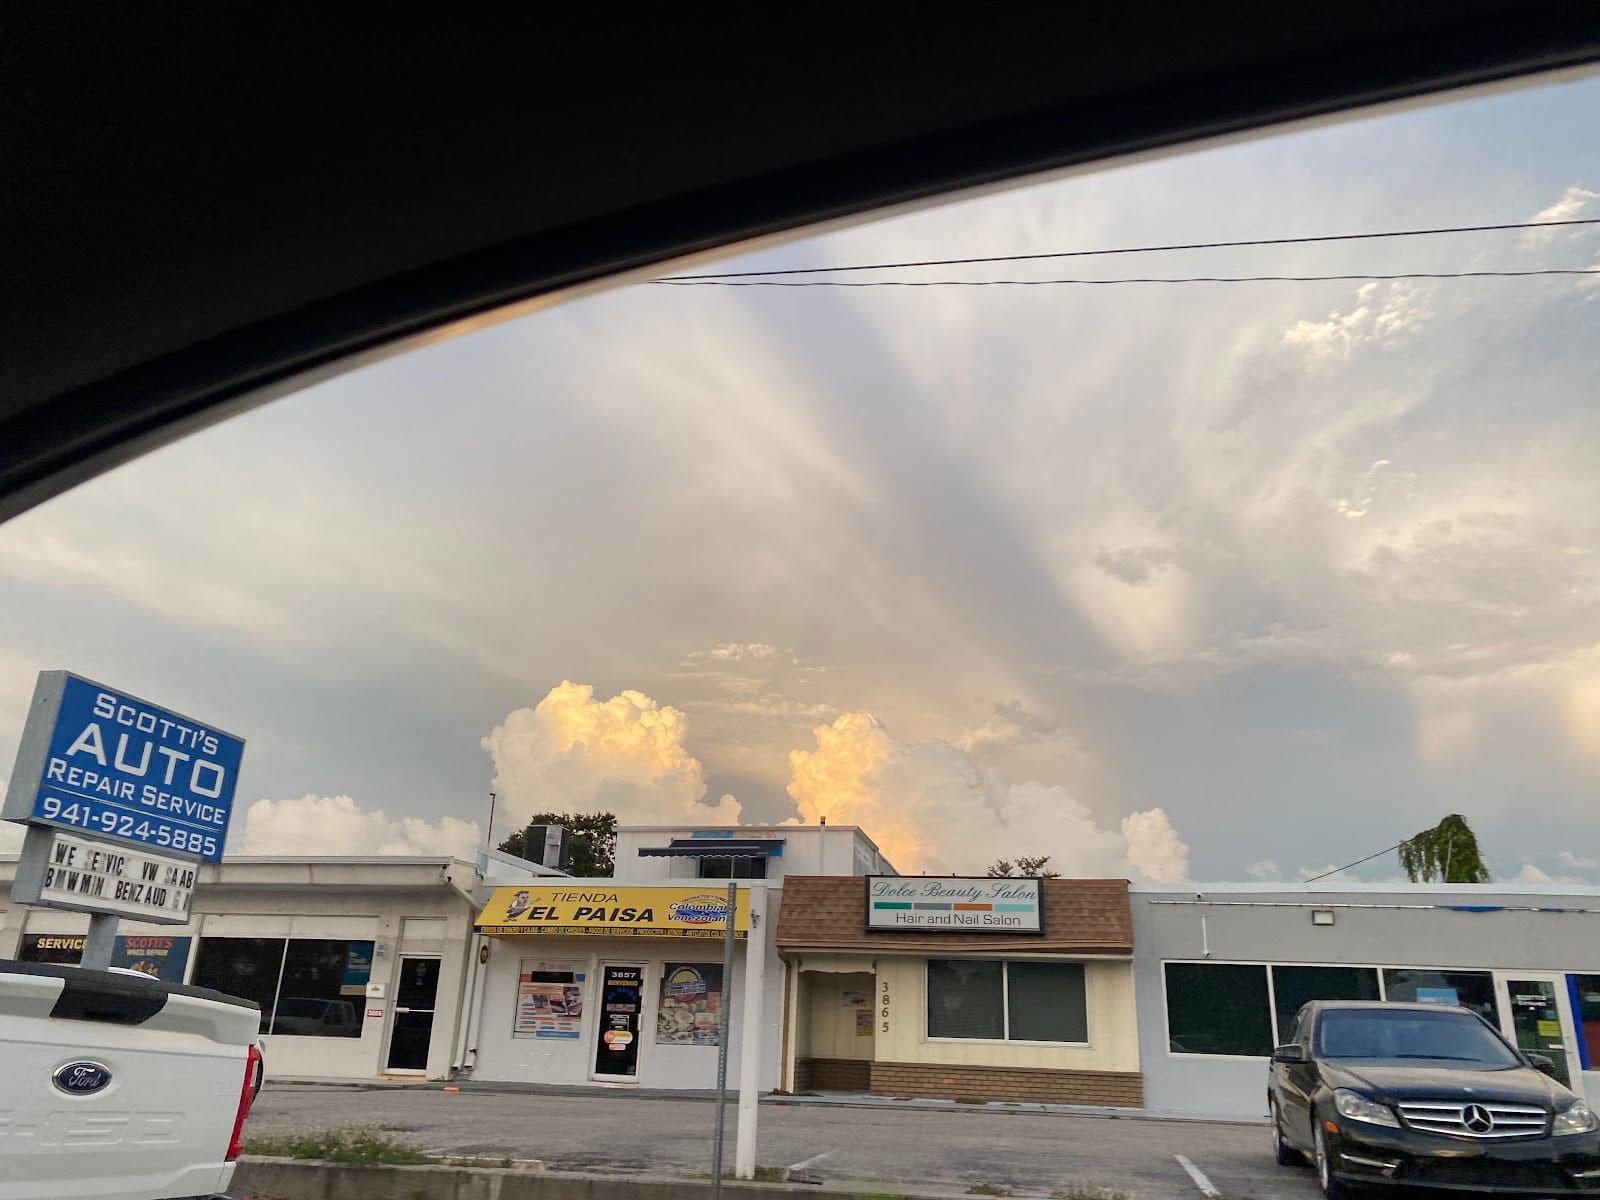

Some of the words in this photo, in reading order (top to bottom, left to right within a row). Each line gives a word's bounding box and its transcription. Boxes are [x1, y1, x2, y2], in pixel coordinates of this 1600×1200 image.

[93, 692, 220, 756] SCOTTI'S
[65, 722, 226, 799] AUTO
[47, 757, 136, 801] REPAIR
[140, 784, 227, 825] SERVICE
[43, 797, 217, 856] 941-924-5885
[55, 843, 77, 866] WE
[142, 861, 159, 881] VW
[114, 880, 145, 902] BENZ
[551, 892, 618, 903] TIENDA
[871, 881, 917, 898] Dolce
[920, 881, 983, 903] Beauty
[986, 882, 1037, 900] Salon
[527, 906, 560, 921] EL
[572, 906, 654, 923] PAISA
[667, 913, 727, 923] Venezolan
[669, 902, 738, 912] Colombia
[896, 912, 925, 924] Hair
[927, 914, 951, 925] and
[953, 914, 979, 926] Nail
[983, 915, 1021, 926] Salon
[68, 1066, 102, 1087] Ford
